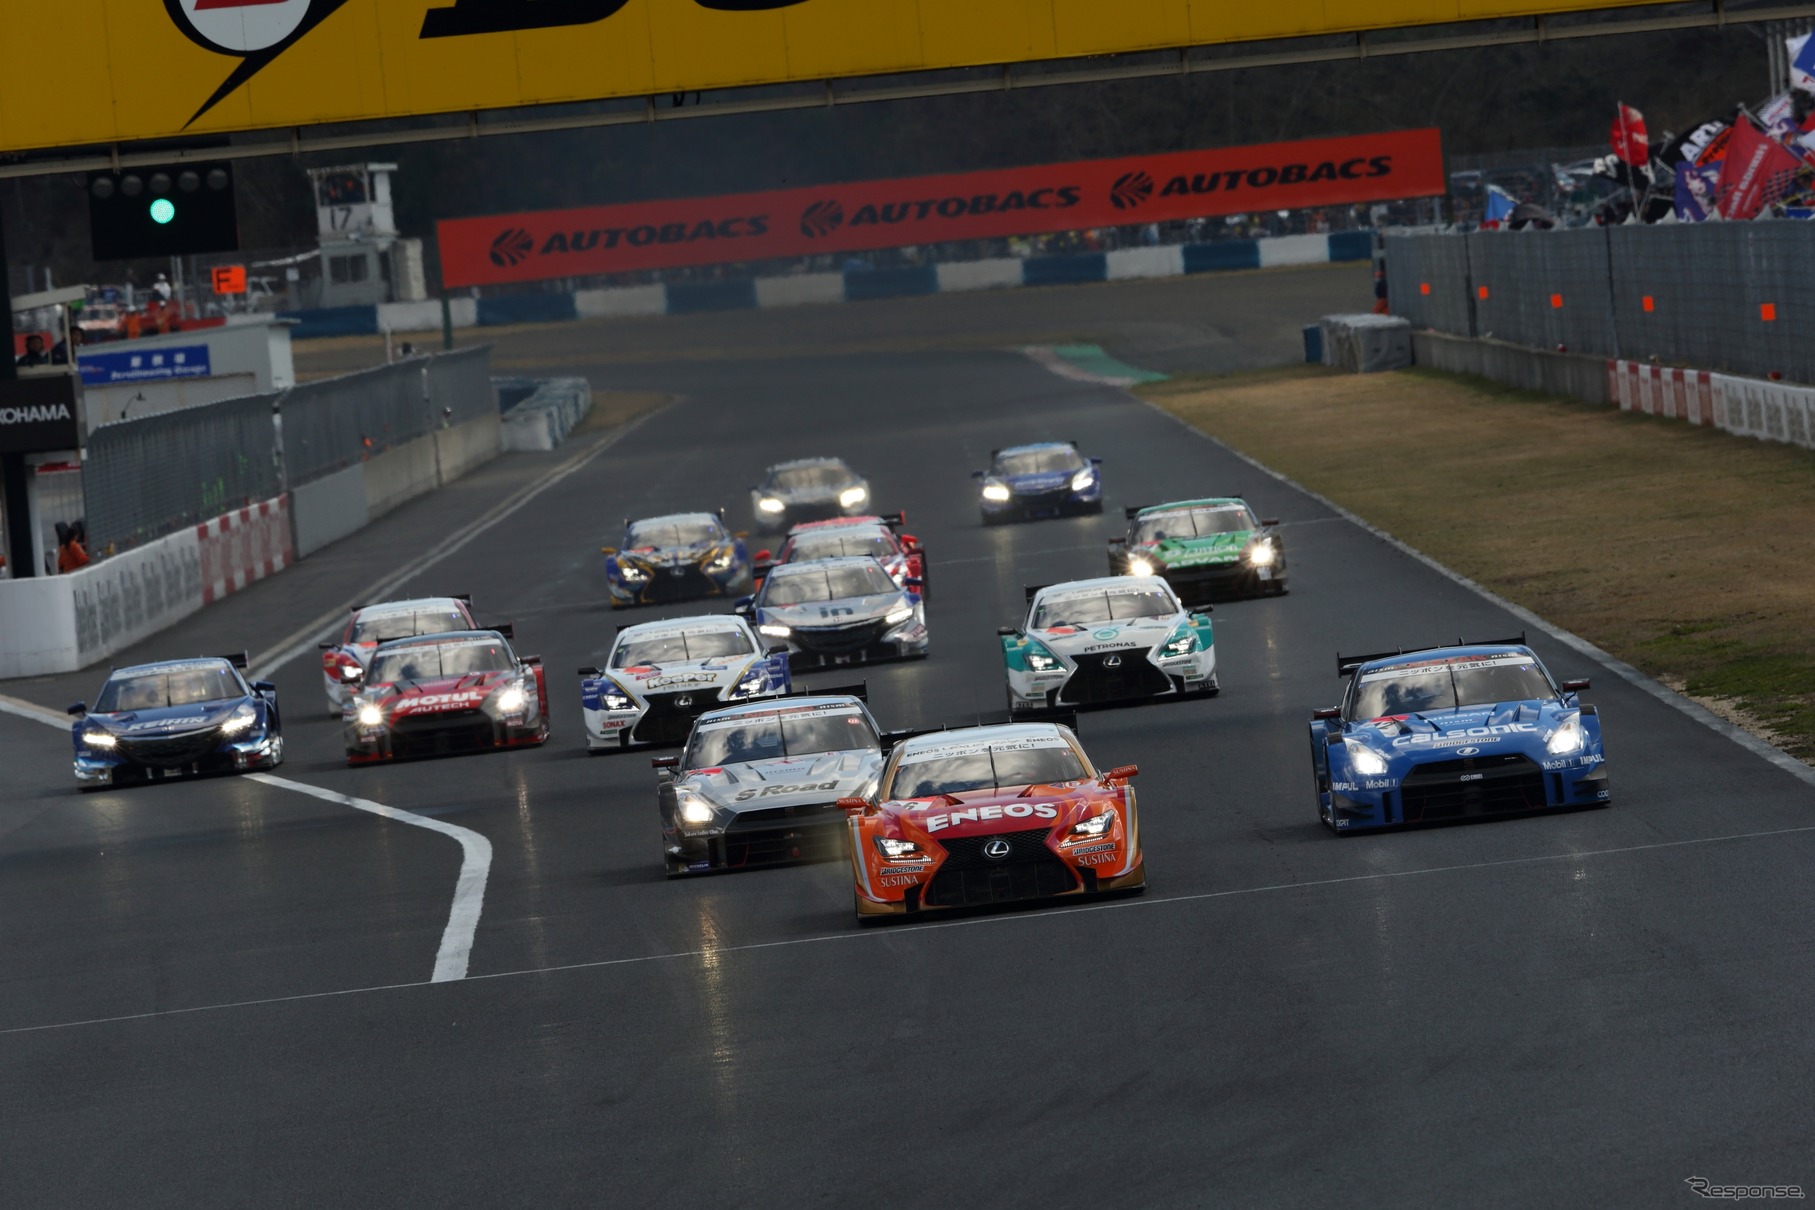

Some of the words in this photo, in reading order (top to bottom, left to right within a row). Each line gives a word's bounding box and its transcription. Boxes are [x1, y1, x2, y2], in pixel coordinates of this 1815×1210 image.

[1159, 156, 1392, 197] AUTOBACS
[849, 186, 1081, 226] AUTOBACS
[331, 206, 353, 230] 17
[539, 214, 770, 255] AUTOBACS
[216, 267, 232, 292] F
[1084, 641, 1137, 652] PETRONAS
[396, 691, 483, 709] MOTUL
[409, 702, 470, 713] AUTECH
[603, 720, 625, 729] SONAX
[1433, 737, 1500, 748] BRIDGESTONE
[907, 748, 939, 757] ENEOS
[1543, 760, 1566, 770] Mobil
[1580, 754, 1605, 765] IMPUL
[1333, 782, 1359, 791] IMPUL
[1366, 779, 1389, 789] Mobil
[735, 789, 759, 801] S
[760, 780, 840, 797] Road
[926, 803, 1057, 833] ENEOS
[1074, 843, 1115, 855] BRIDGESTONE
[1078, 854, 1116, 866] SUSTINA
[880, 866, 924, 875] BRIDGESTONE
[881, 876, 919, 887] SUSTINA
